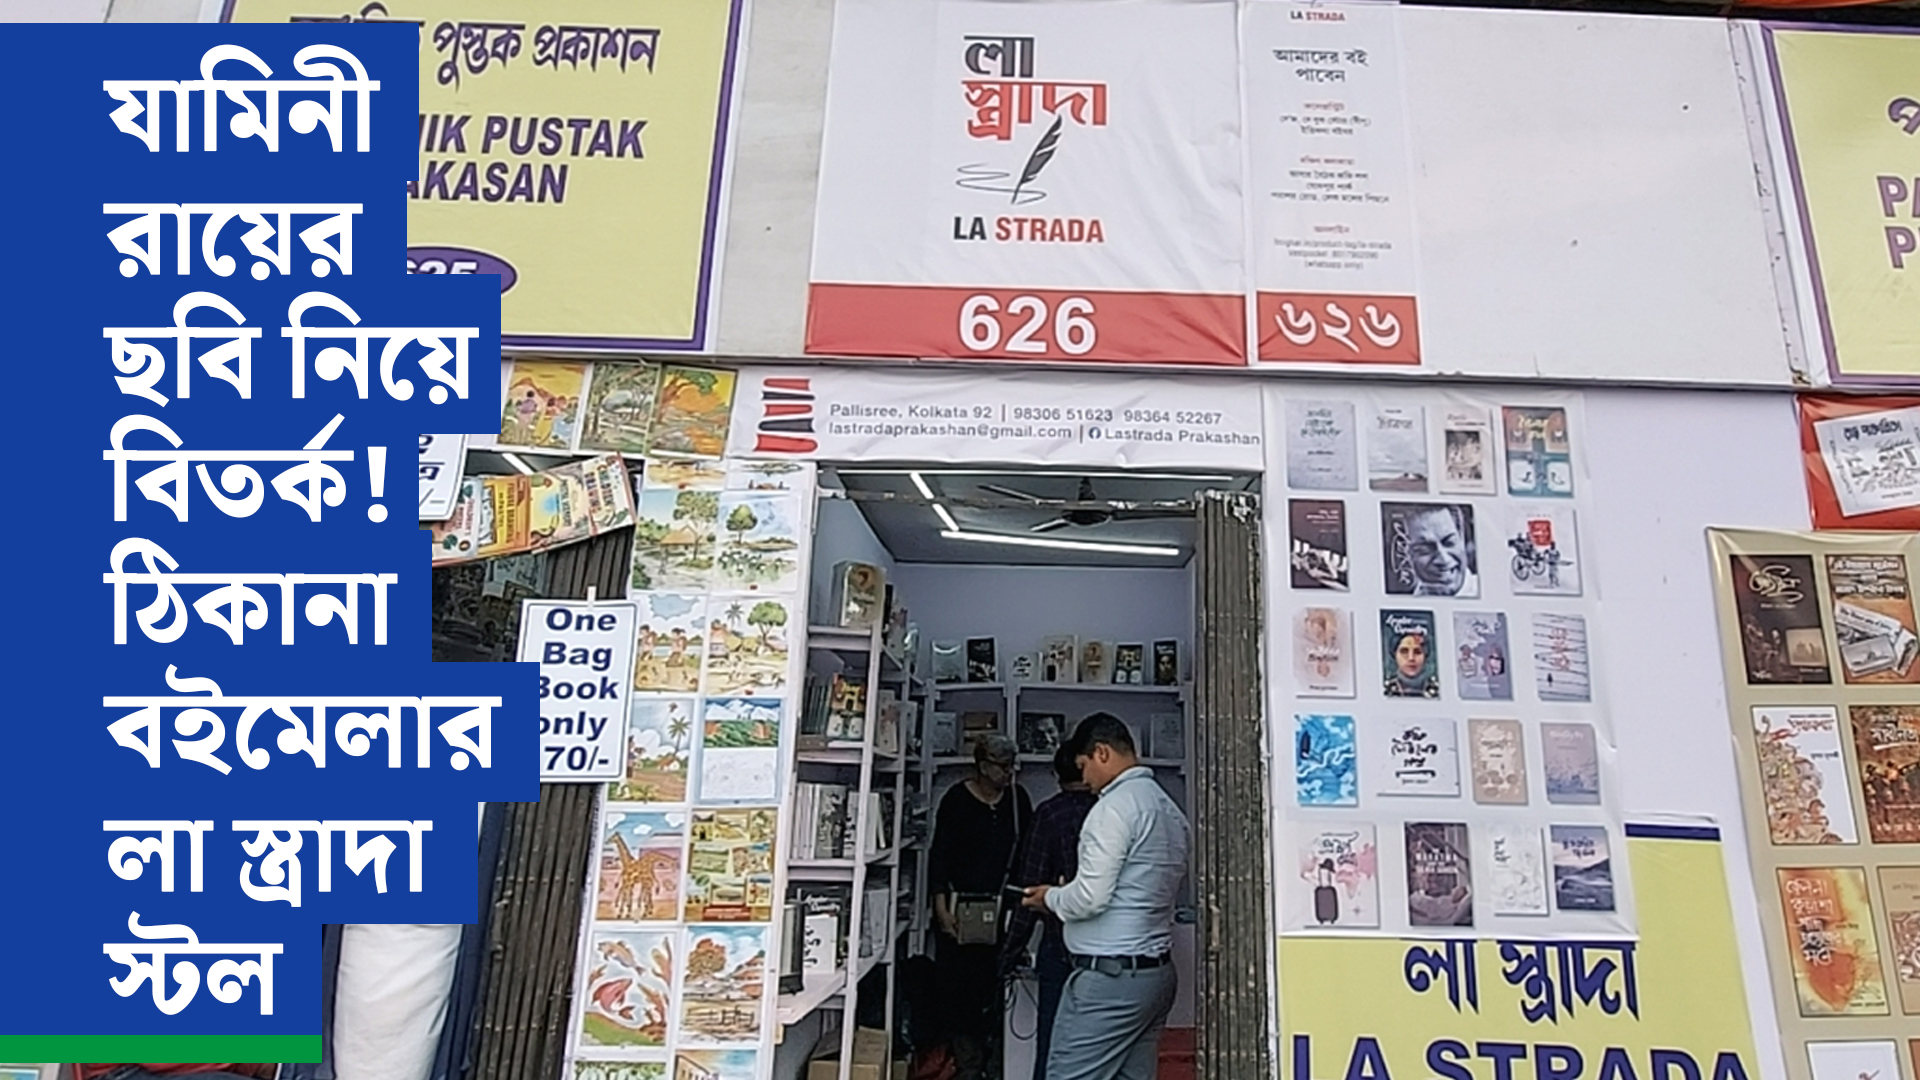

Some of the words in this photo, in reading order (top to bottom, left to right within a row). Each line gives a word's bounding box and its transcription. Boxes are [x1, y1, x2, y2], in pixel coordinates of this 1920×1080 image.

[1290, 10, 1303, 20] LA
[1306, 12, 1346, 22] STRADA
[433, 22, 525, 92] পুস্তক
[532, 26, 661, 74] প্রকাশন
[963, 35, 1035, 79] লা
[1272, 49, 1340, 64] আমাদের
[1345, 49, 1370, 67] বই
[1295, 68, 1346, 83] পাবেন
[962, 80, 1107, 140] স্ত্রাদা
[481, 115, 647, 159] PUSTAK
[953, 216, 987, 240] LA
[995, 217, 1105, 243] STRADA
[958, 295, 1097, 355] 626
[1274, 302, 1402, 354] ৬২৬
[830, 404, 903, 418] Pallisree,
[908, 405, 968, 418] Kolkata
[973, 406, 993, 419] 92
[1013, 408, 1061, 421] 98306
[1066, 409, 1114, 422] 51623
[1124, 410, 1170, 423] 98364
[1176, 411, 1222, 424] 52267
[829, 421, 1072, 440] lastradaprakashan@gmail.com
[1105, 428, 1173, 442] Lastrada
[1179, 430, 1261, 445] Prakashan
[546, 608, 617, 631] One
[542, 642, 612, 671] Bag
[540, 711, 608, 741] only
[544, 746, 609, 771] 70/-
[1400, 939, 1479, 1015] লা
[1496, 940, 1640, 1025] স্ত্রাদা
